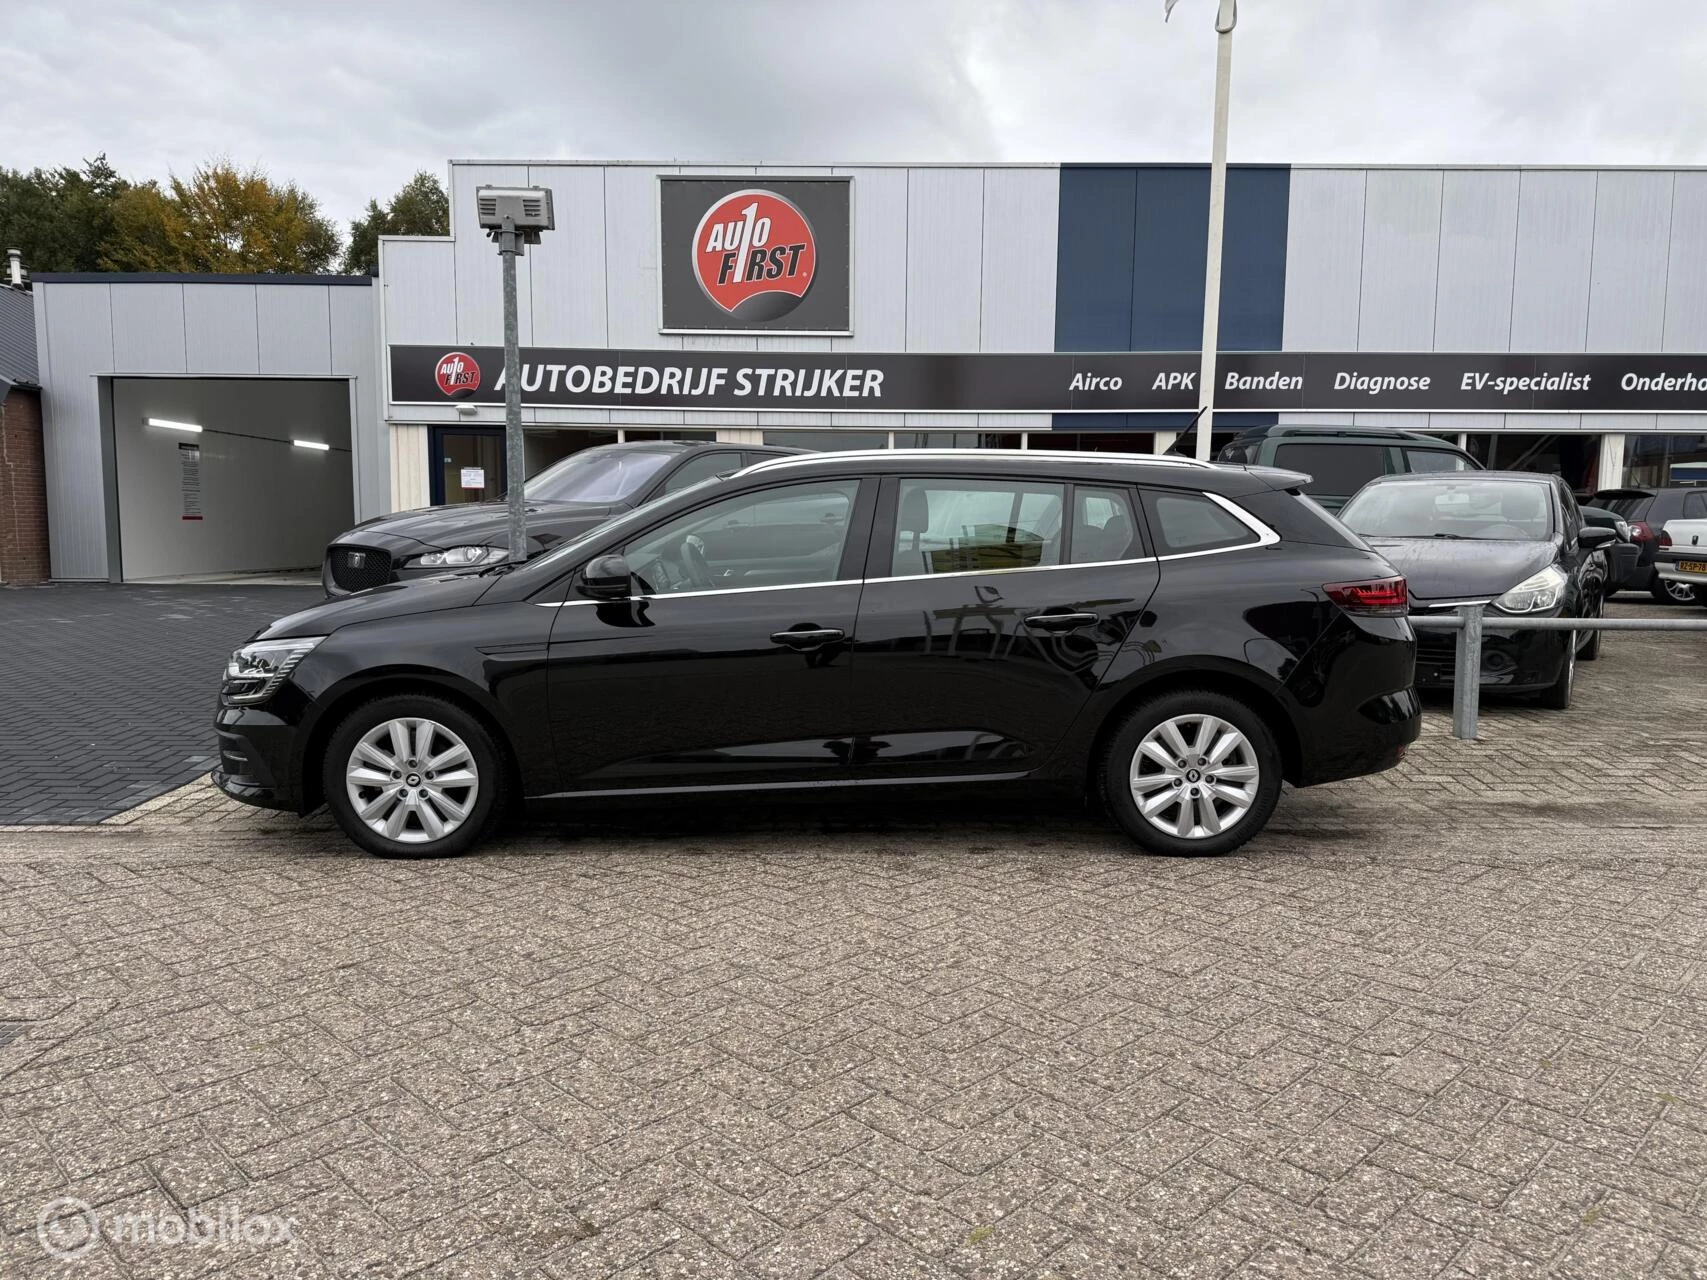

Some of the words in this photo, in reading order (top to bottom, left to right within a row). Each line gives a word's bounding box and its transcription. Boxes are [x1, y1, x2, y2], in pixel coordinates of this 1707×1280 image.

[733, 368, 884, 397] STRIJKER
[1069, 372, 1123, 391] Airco
[1152, 372, 1197, 390] APK
[1224, 372, 1303, 390] Banden
[1334, 372, 1431, 395] Diagnose
[1461, 372, 1592, 395] EV-specialist
[1621, 372, 1707, 391] Onderho
